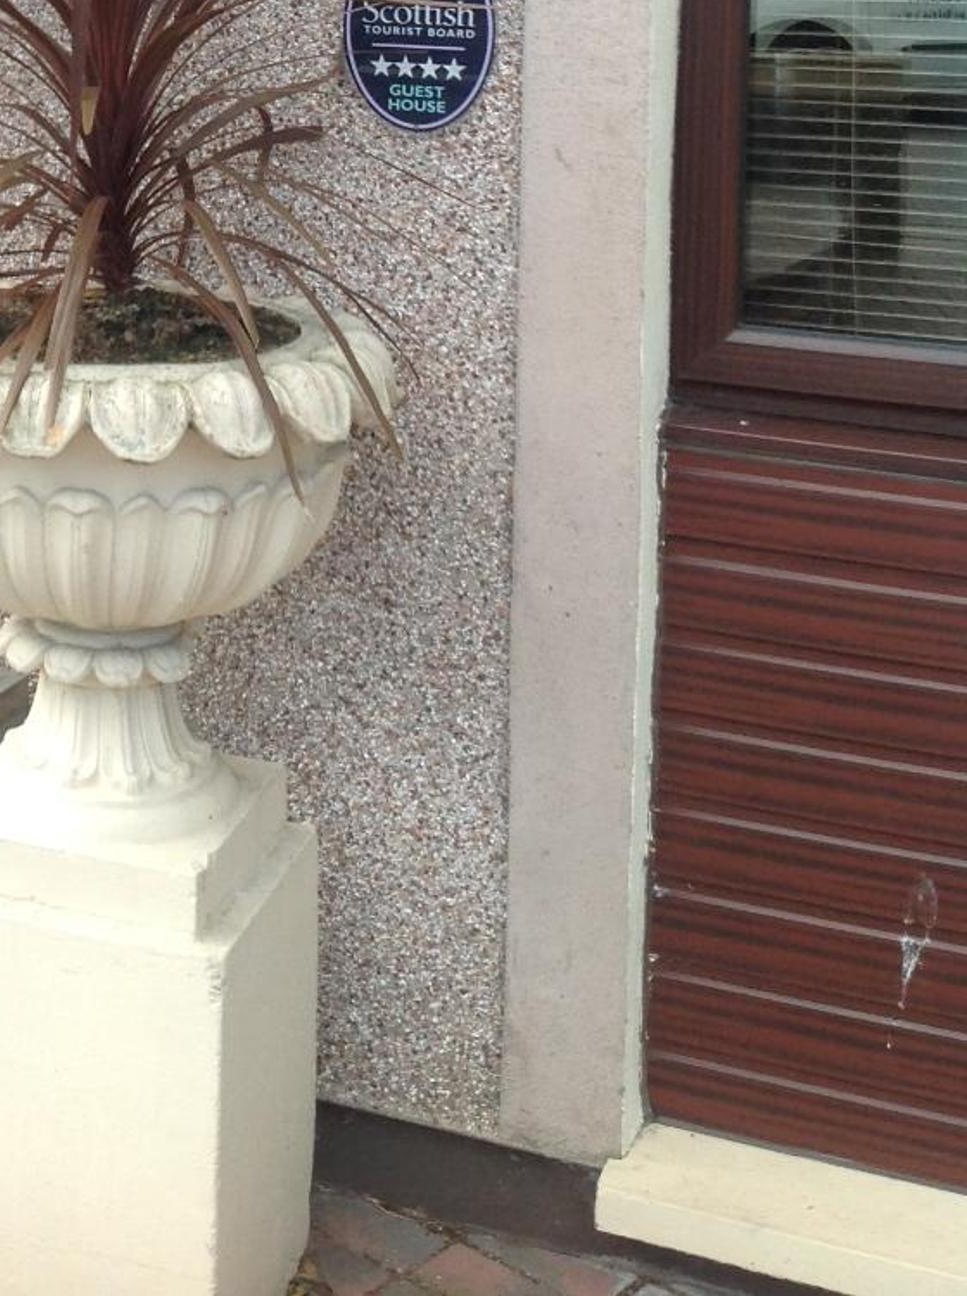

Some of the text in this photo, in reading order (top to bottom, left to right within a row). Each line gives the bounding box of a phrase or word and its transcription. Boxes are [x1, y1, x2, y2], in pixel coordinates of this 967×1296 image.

[362, 1, 476, 28] Scottish
[364, 25, 476, 39] TOURIST BOARD
[389, 84, 446, 98] GUEST
[387, 98, 447, 114] HOUSE
